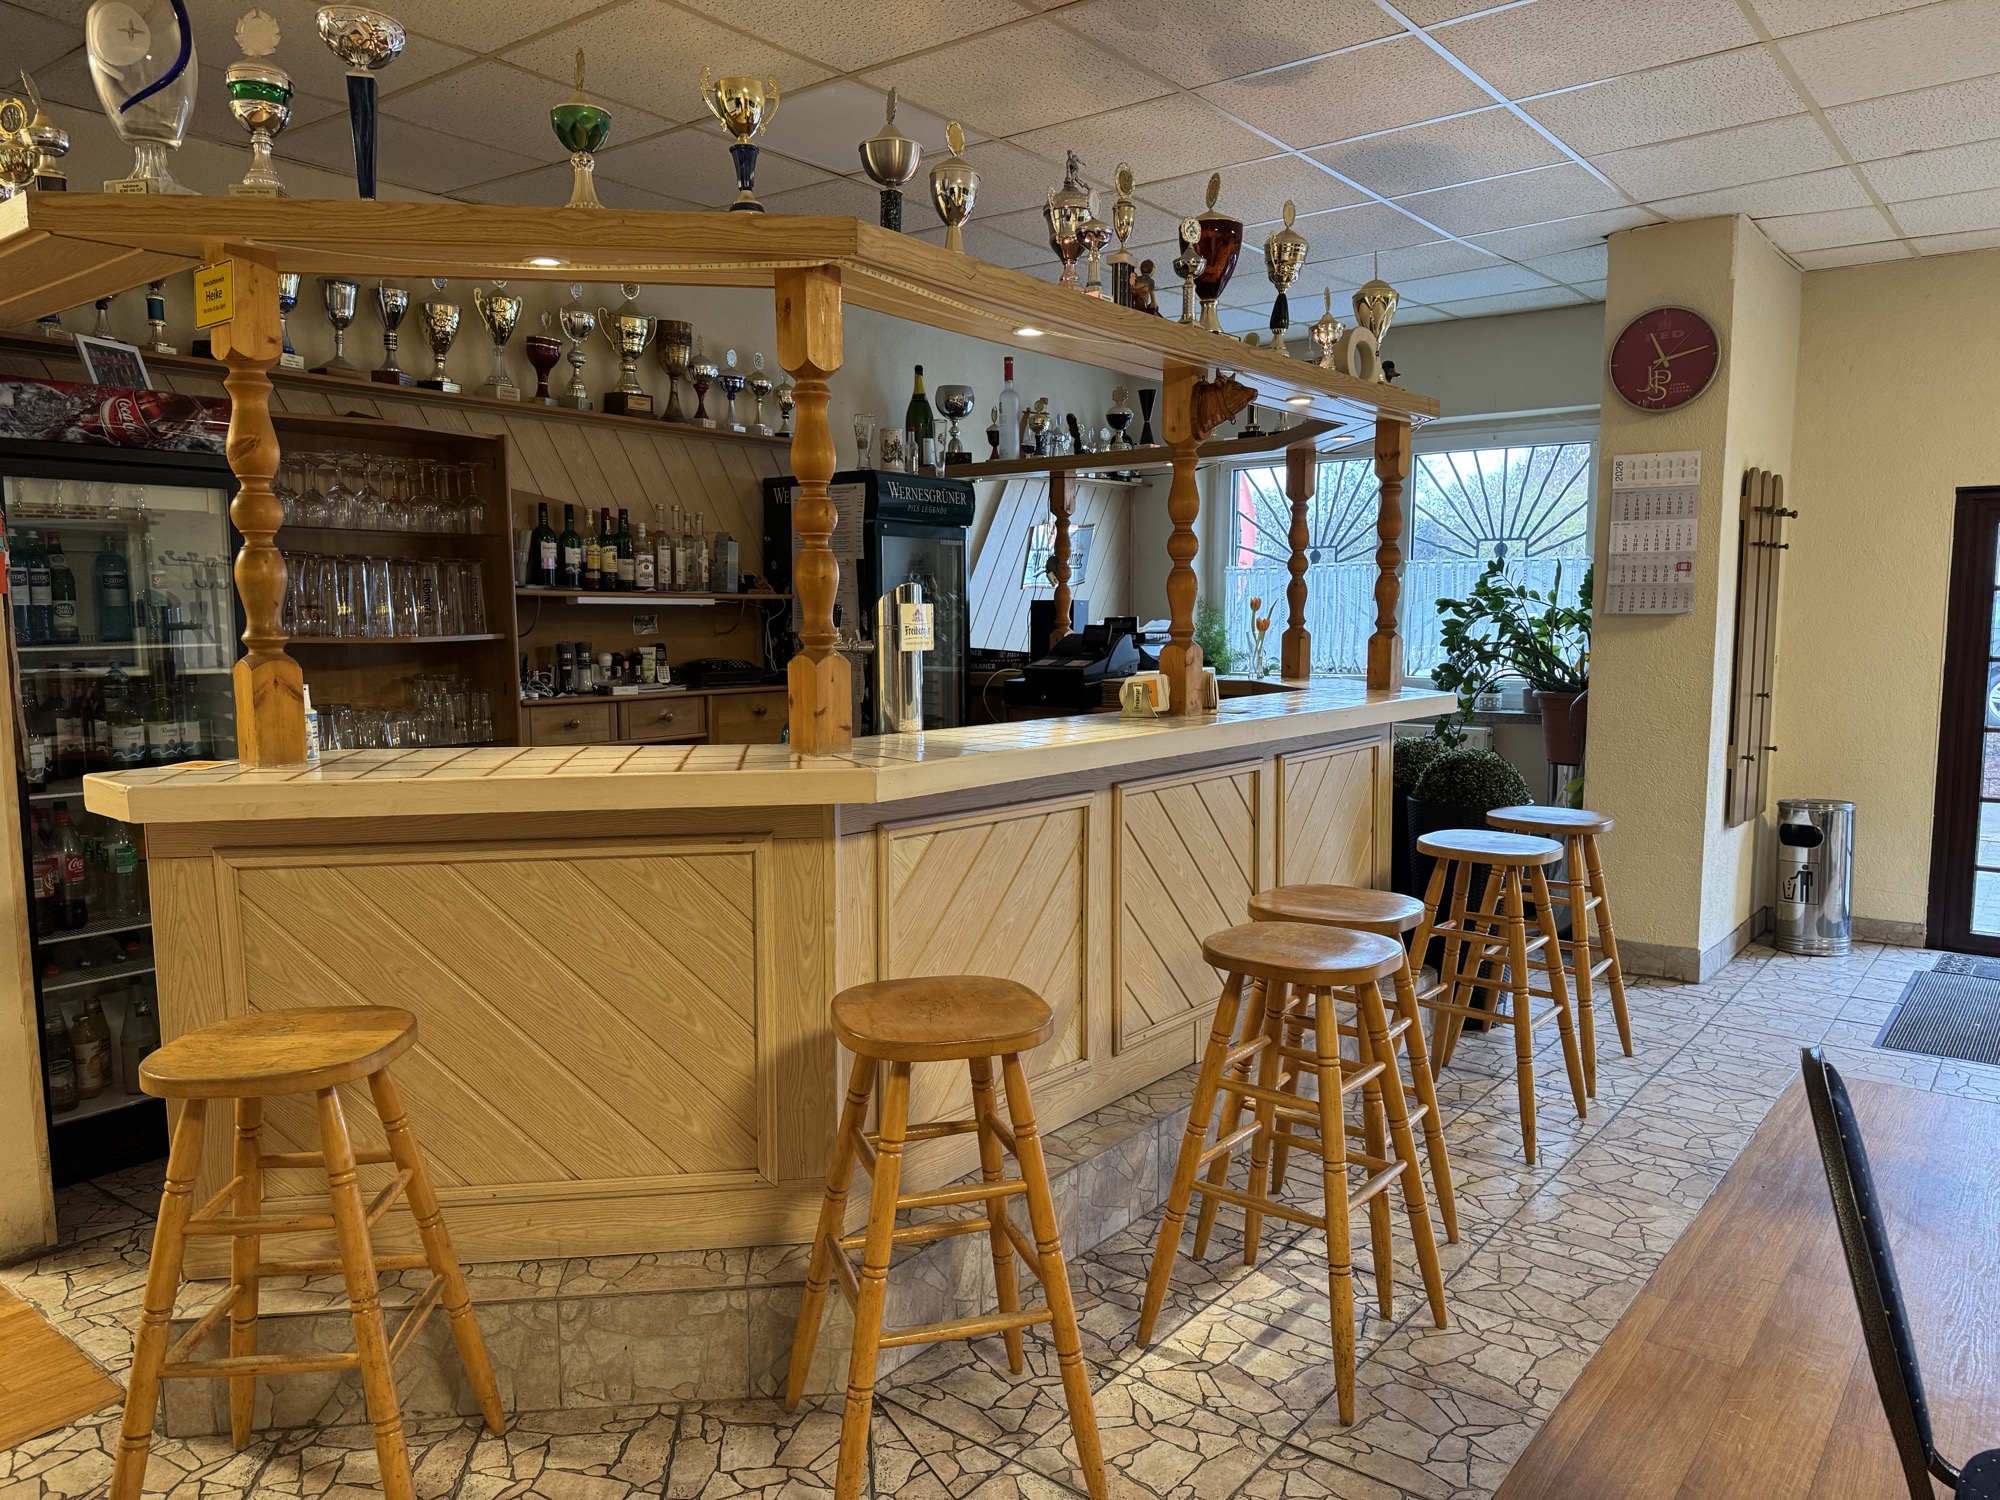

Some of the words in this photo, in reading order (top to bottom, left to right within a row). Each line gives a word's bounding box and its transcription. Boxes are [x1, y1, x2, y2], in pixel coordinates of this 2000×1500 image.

[205, 288, 223, 302] Heike
[1614, 460, 1624, 482] 2026
[907, 504, 920, 512] PILS
[921, 505, 947, 514] LEGENDE
[422, 579, 432, 618] ERDINGER
